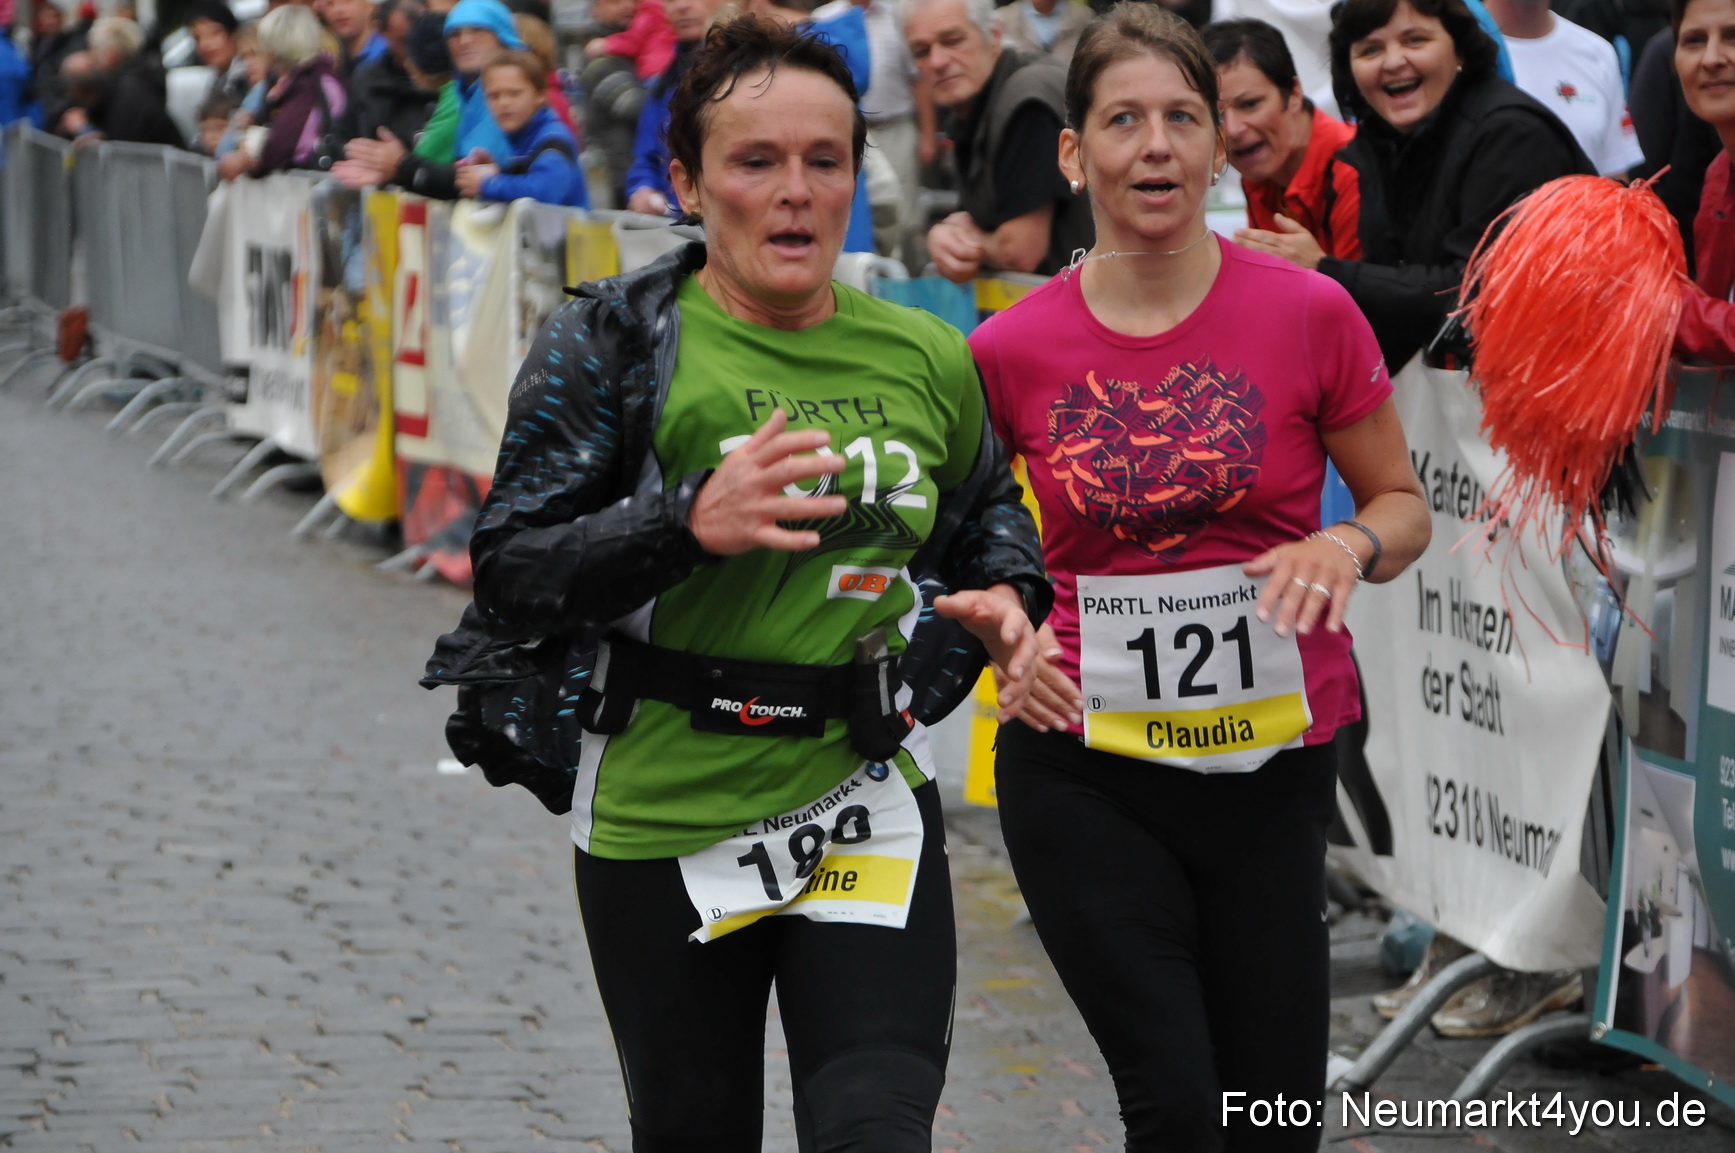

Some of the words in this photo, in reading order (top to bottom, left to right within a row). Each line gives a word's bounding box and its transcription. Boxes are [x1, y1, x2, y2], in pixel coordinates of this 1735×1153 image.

[745, 388, 888, 427] FÜRTH
[719, 434, 927, 509] 12
[838, 573, 895, 594] OB
[1083, 596, 1153, 615] PARTL
[1158, 584, 1257, 614] Neumarkt
[1417, 568, 1442, 634] Im
[1126, 615, 1254, 700] 121
[711, 697, 743, 713] PRO
[749, 704, 803, 718] TOUCH
[1092, 697, 1101, 710] D
[1422, 651, 1454, 716] der
[1460, 659, 1504, 736] Stadt
[1146, 715, 1254, 749] Claudia
[763, 778, 862, 834] Neumarkt
[711, 907, 722, 920] D
